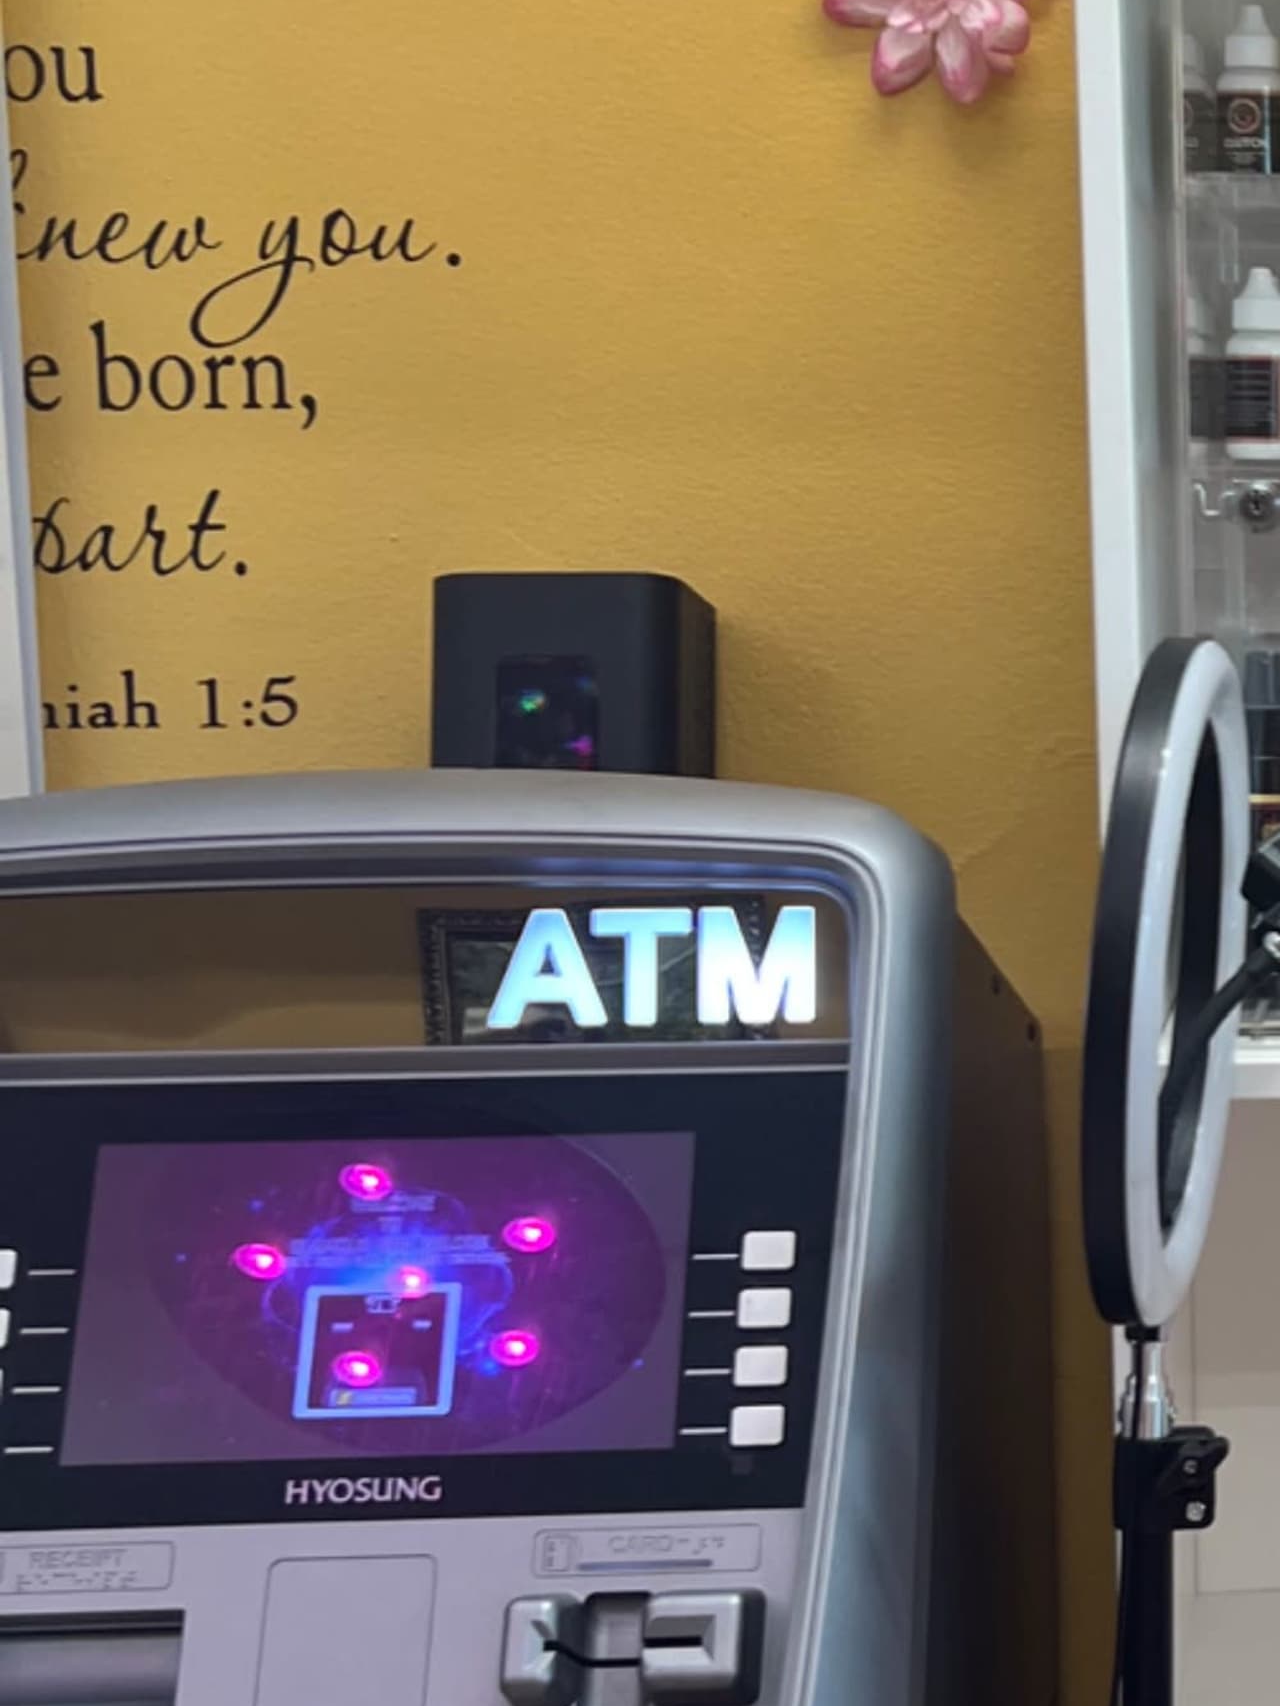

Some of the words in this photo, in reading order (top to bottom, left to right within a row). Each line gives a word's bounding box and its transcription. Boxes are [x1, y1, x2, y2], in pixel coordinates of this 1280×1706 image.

[189, 207, 463, 349] you.
[88, 318, 319, 430] born,
[196, 676, 299, 730] 1:5
[486, 905, 818, 1029] ATM
[284, 1474, 443, 1505] HYOSUNG
